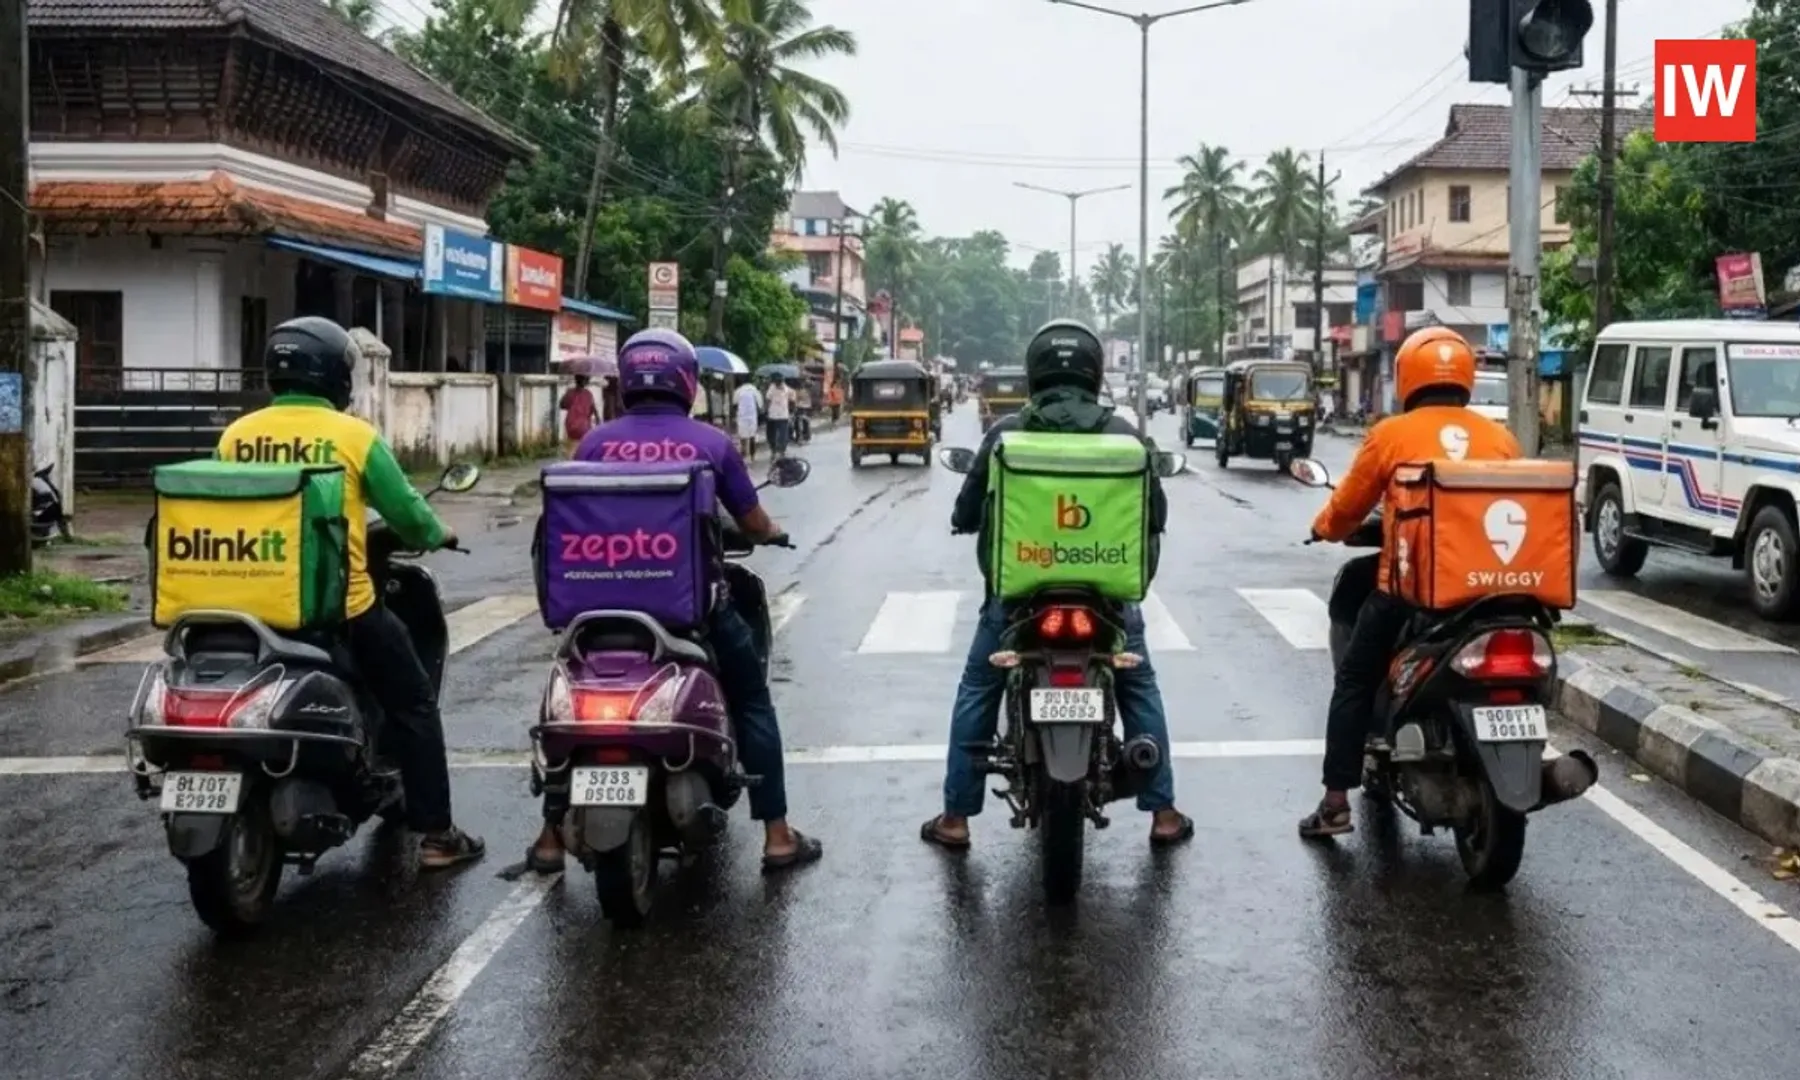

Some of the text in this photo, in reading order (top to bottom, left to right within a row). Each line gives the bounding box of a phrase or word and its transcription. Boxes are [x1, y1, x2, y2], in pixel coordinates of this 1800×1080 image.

[235, 437, 337, 464] blinkit
[602, 438, 697, 462] zepto
[168, 527, 287, 562] blinkit
[561, 528, 677, 568] zepto
[1017, 540, 1129, 568] bigbasket
[1468, 571, 1545, 587] SWIGGY
